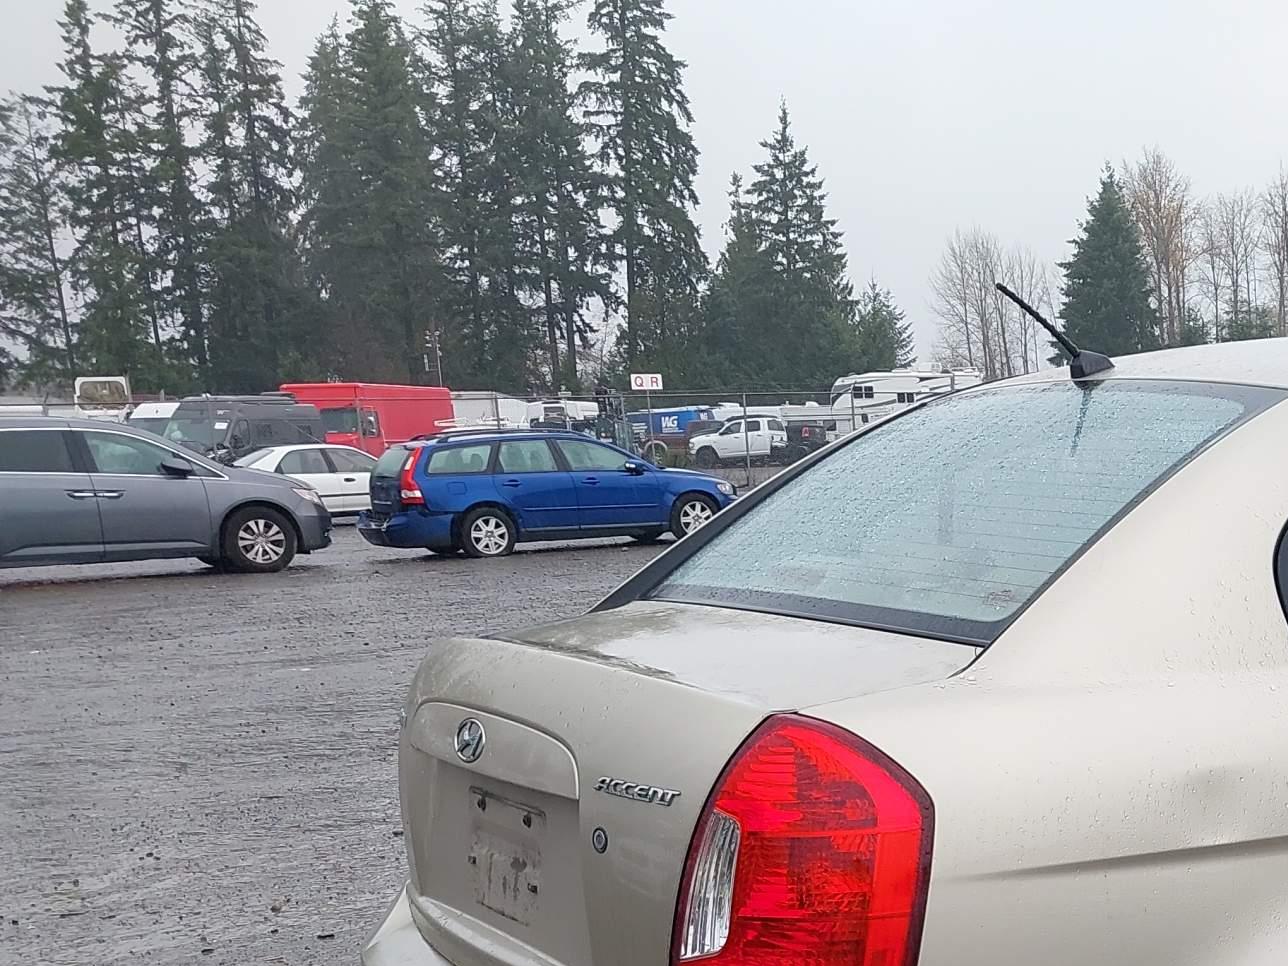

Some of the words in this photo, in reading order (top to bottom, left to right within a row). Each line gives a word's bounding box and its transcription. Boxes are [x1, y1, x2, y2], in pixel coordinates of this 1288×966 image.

[634, 375, 644, 388] Q
[650, 376, 659, 388] R
[593, 776, 681, 807] ACCENT
